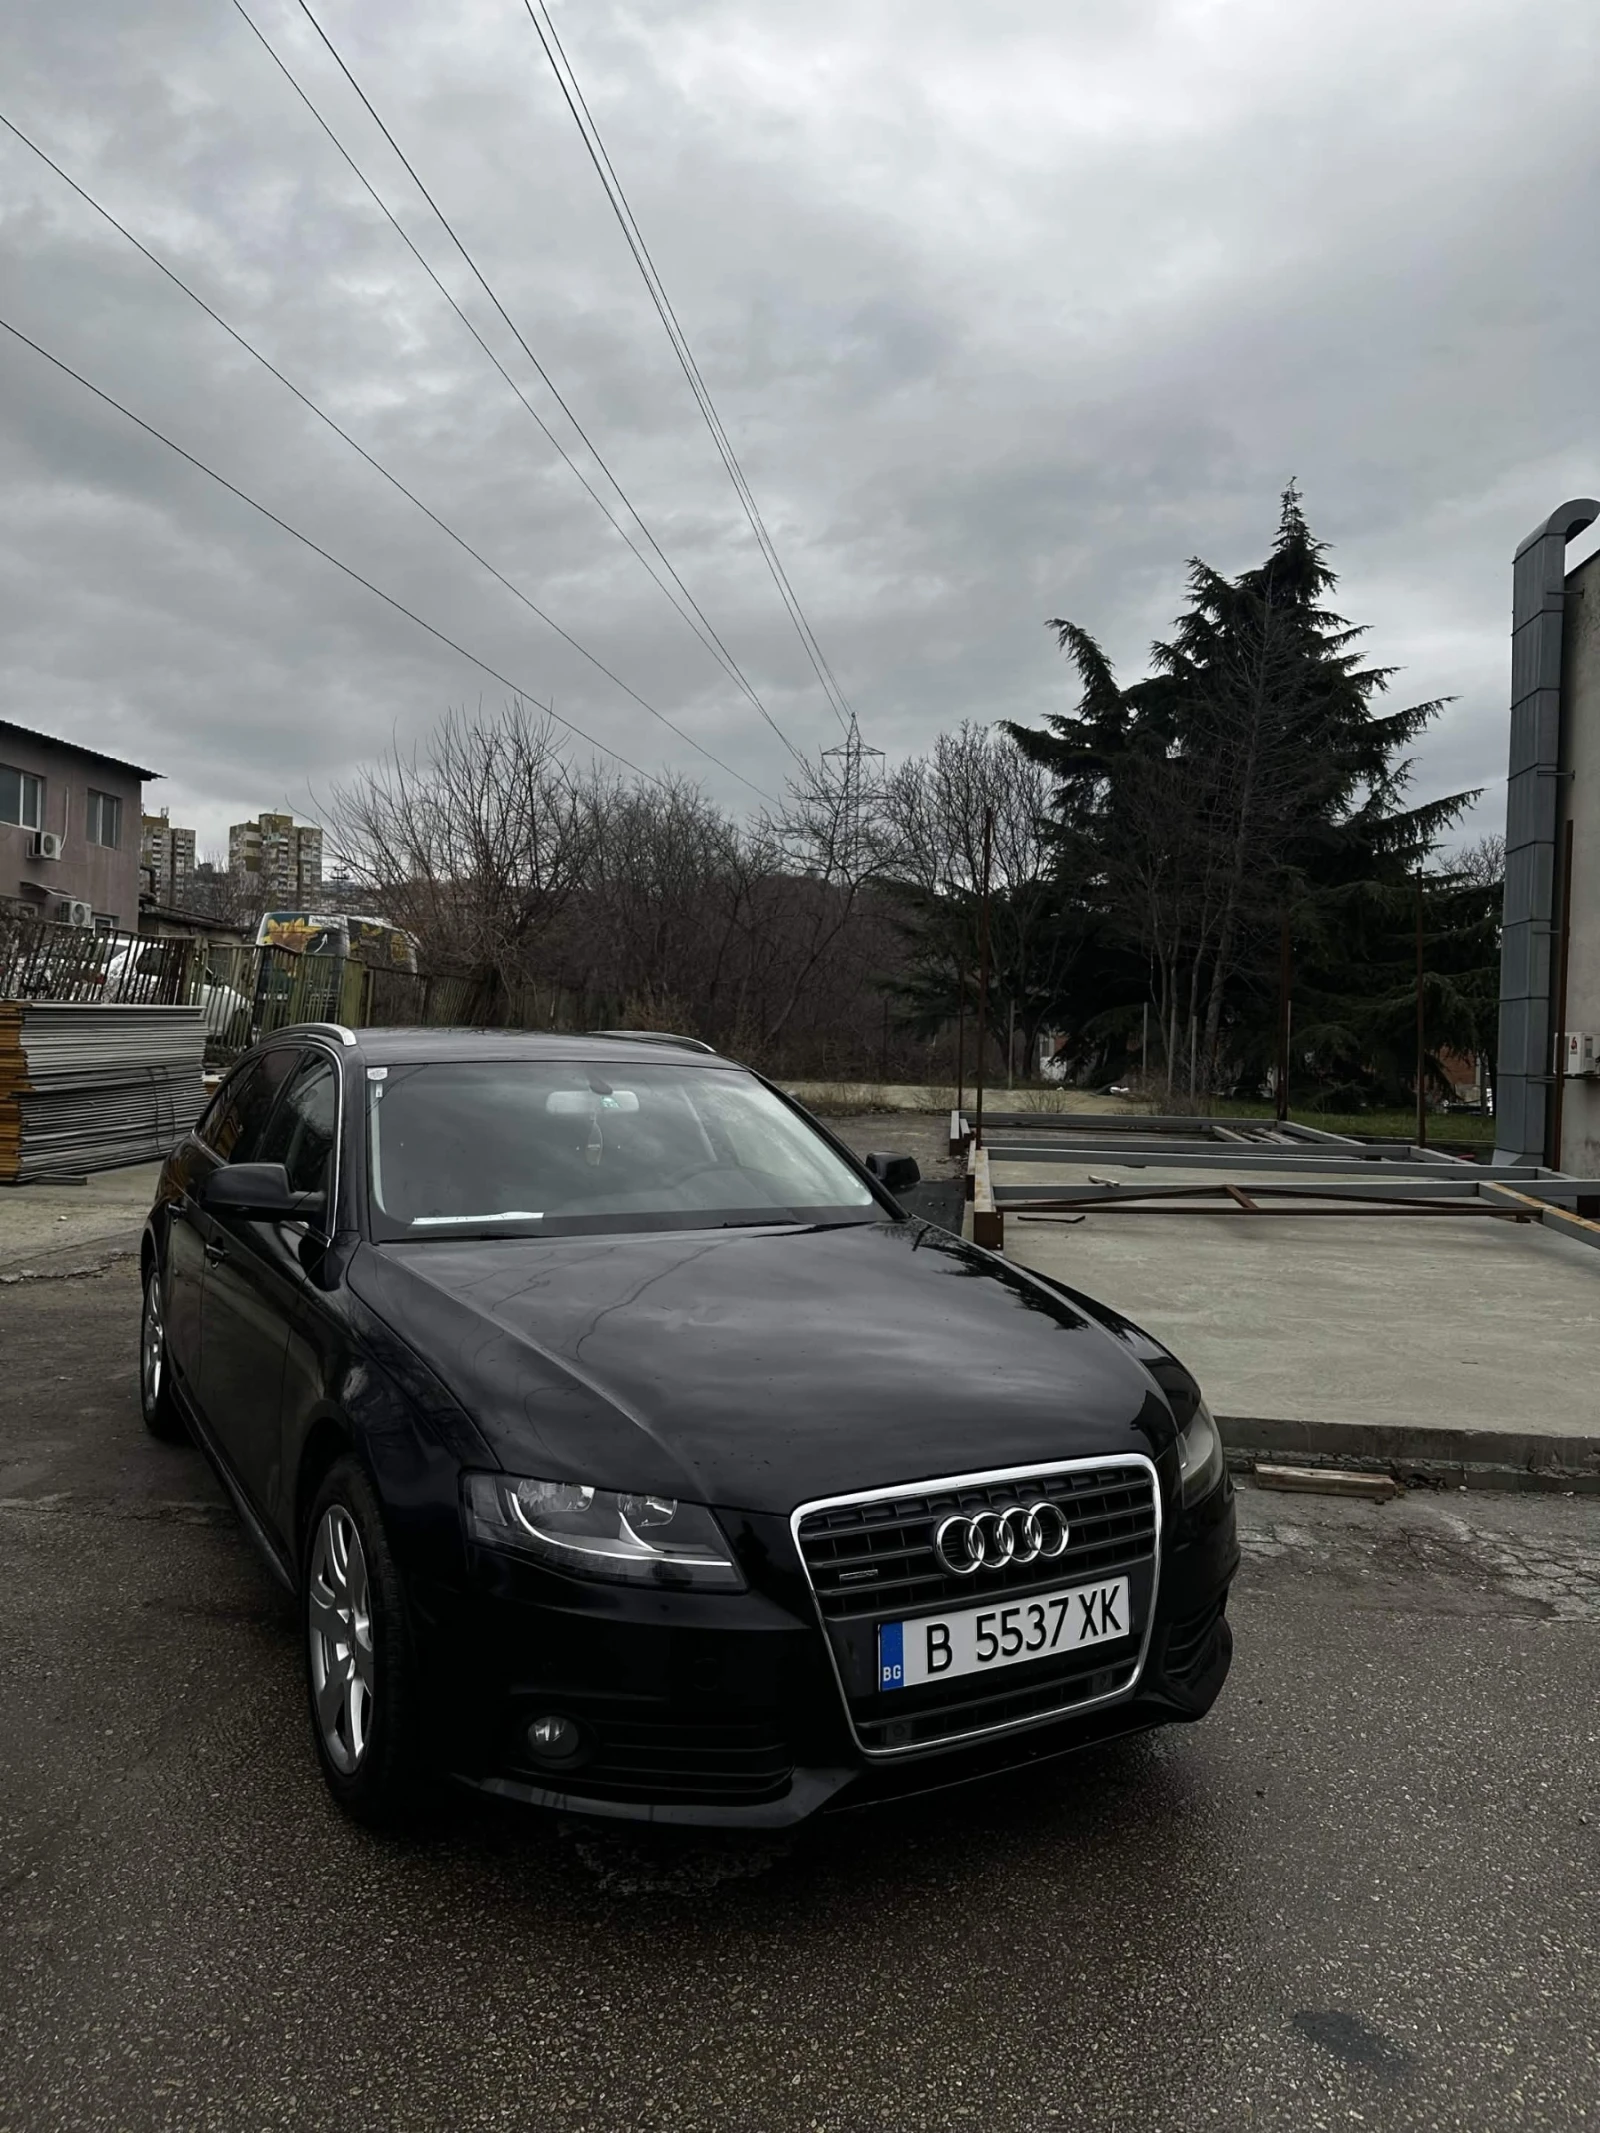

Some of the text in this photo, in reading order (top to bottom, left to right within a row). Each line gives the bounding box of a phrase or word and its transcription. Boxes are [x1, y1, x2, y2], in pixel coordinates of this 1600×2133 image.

[926, 1584, 1122, 1675] B 5537 XK
[883, 1664, 902, 1682] BG
